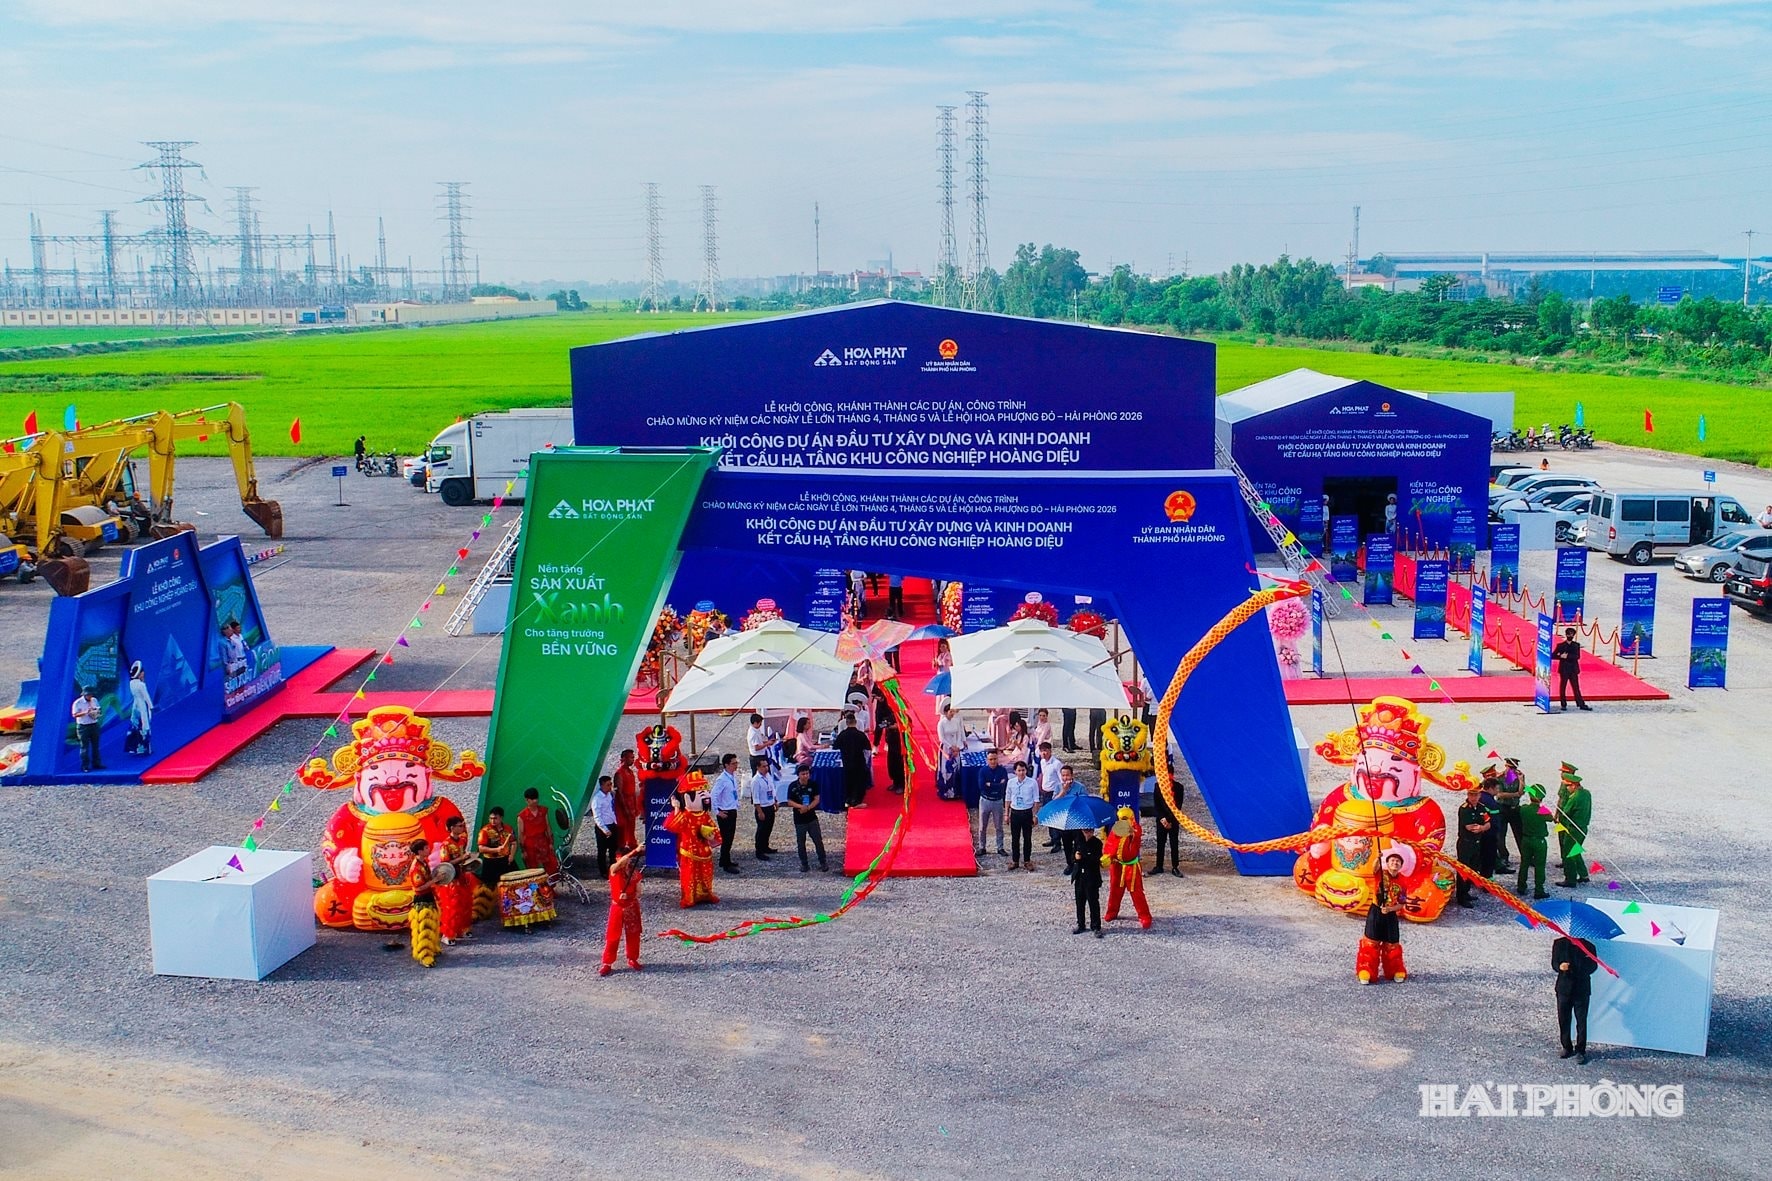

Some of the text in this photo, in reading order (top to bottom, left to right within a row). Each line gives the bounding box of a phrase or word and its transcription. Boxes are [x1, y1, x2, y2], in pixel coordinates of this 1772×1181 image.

[765, 399, 1026, 412] LỄ KHỞI CÔNG, KHÁNH THÀNH CÁC DỰ ÁN, CÔNG TRÌNH
[647, 410, 1142, 426] CHÀO MỪNG KỶ NIỆM CÁC NGÀY LỄ LỚN THÁNG 4, THÁNG 5 VÀ LỄ HỘI HOA PHƯỢNG ĐỎ HẢI PHÒNG 2026
[700, 430, 1090, 449] KHỞI CÔNG DỰ ÁN ĐẦU TƯ XÂY DỰNG VÀ KINH DOANH
[747, 449, 778, 466] CẤU
[782, 453, 805, 468] HẠ
[806, 449, 847, 465] TẦNG
[851, 452, 882, 464] KHU
[885, 448, 929, 464] CÔNG
[932, 448, 986, 465] NGHIỆP
[990, 448, 1043, 463] HOÀNG
[1047, 447, 1079, 465] DIỆU
[800, 491, 1018, 504] LỄ KHỞI CÔNG, KHÁNH THÀNH CÁC DỰ ÁN, CÔNG TRÌNH
[703, 500, 725, 509] CHÀO
[727, 501, 752, 510] MỪNG
[754, 501, 764, 509] KỶ
[767, 501, 786, 511] NIỆM
[788, 502, 805, 510] CÁC
[807, 502, 828, 511] NGÀY
[831, 502, 840, 511] LỄ
[842, 502, 858, 511] LỚN
[860, 503, 888, 512] THÁNG
[899, 504, 927, 512] THÁNG
[935, 504, 946, 512] VÀ
[947, 502, 957, 512] LỄ
[959, 503, 973, 512] HỘI
[994, 505, 1029, 513] PHƯỢNG
[1031, 504, 1043, 513] ĐỎ
[1051, 504, 1064, 512] HẢI
[1066, 504, 1095, 513] PHÒNG
[1097, 505, 1116, 513] 2026
[746, 518, 1072, 534] KHỞI CÔNG DỰ ÁN ĐẦU TƯ XÂY DỰNG VÀ KINH DOANH
[758, 532, 1063, 550] KẾT CẤU HẠ TẦNG KHU CÔNG NGHIỆP HOÀNG DIỆU
[1133, 534, 1225, 543] THÀNH PHỐ HẢI PHÒNG
[538, 563, 583, 575] Nền tảng
[530, 573, 605, 590] SẢN XUẤT
[533, 592, 624, 624] Xanh
[525, 628, 604, 639] Cho tăng trưởng
[542, 638, 617, 655] BỀN VỮNG
